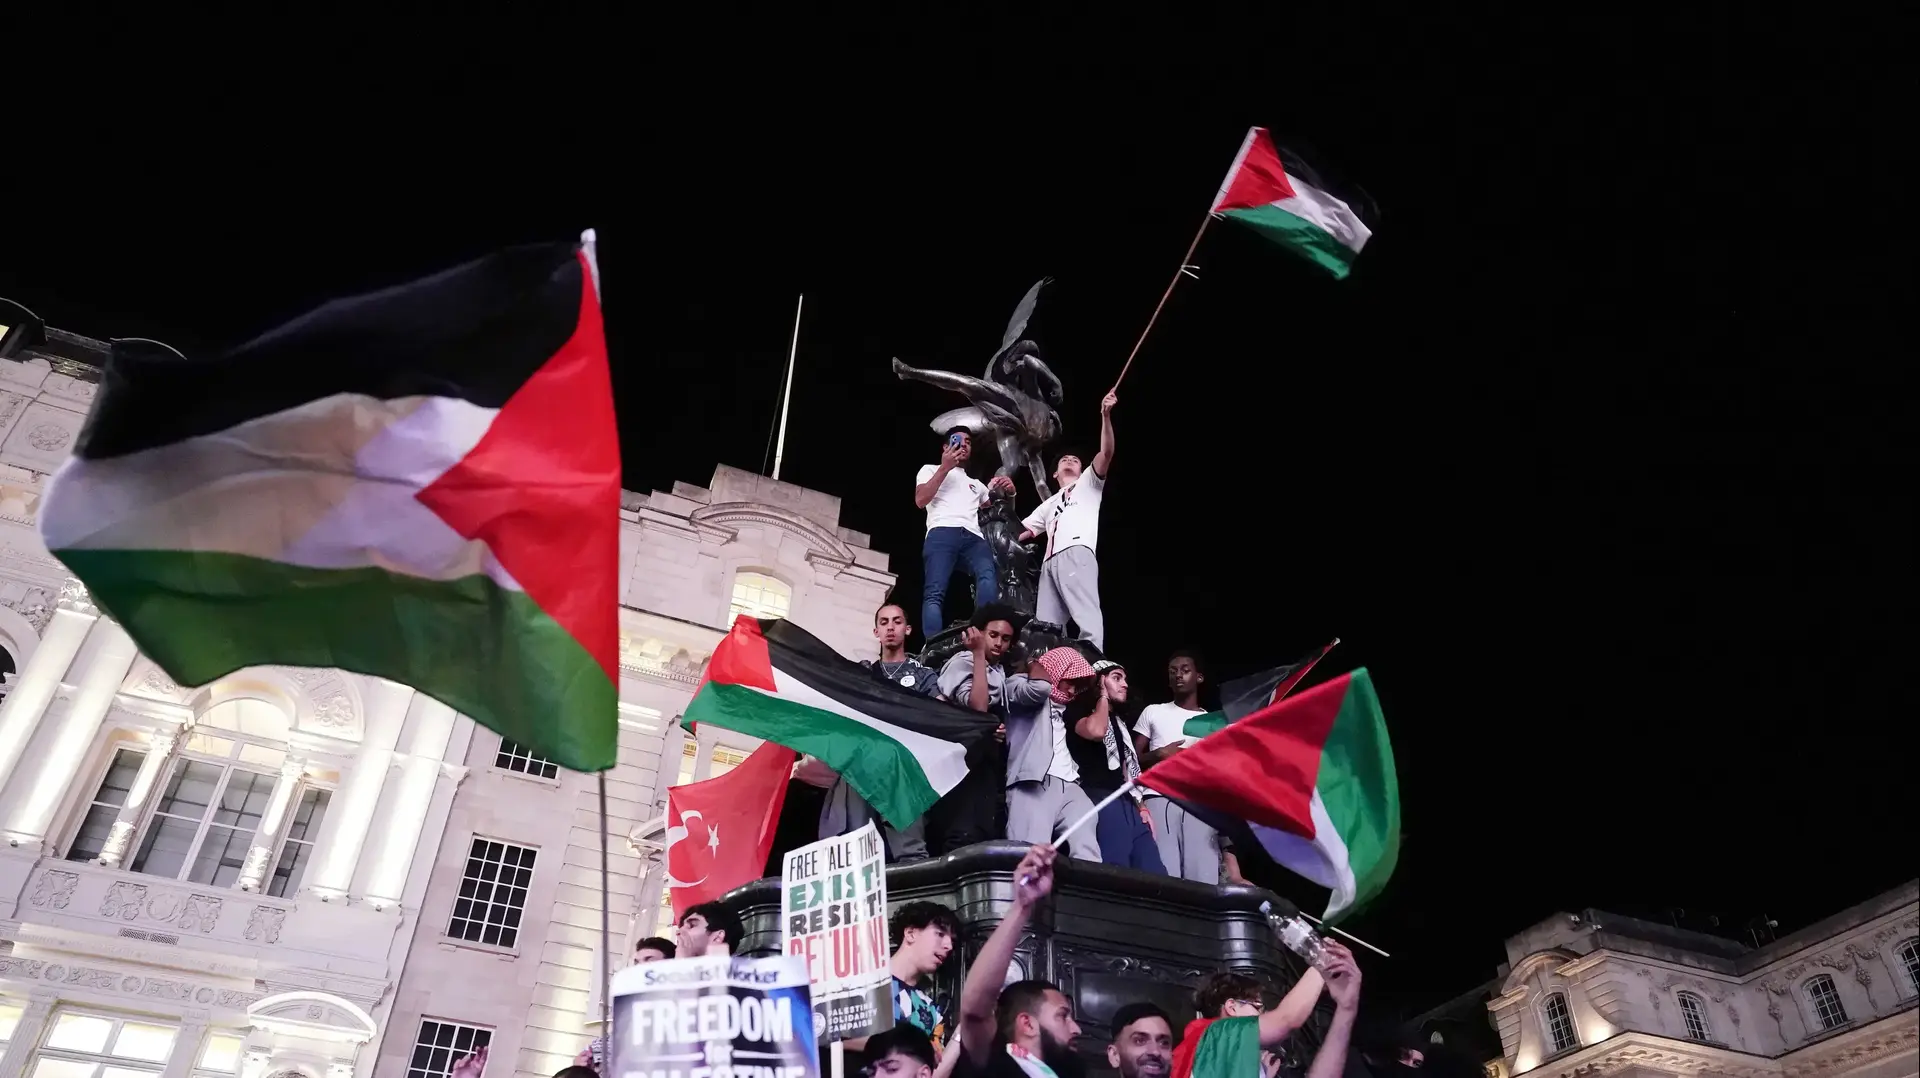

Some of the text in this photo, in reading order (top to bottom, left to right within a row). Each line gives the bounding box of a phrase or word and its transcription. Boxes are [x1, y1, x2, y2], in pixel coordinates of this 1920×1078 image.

[789, 830, 880, 882] FREE ALETINE
[789, 859, 881, 913] EXIST!
[632, 994, 793, 1047] FREEDOM
[828, 1008, 878, 1026] SOLIDARITY
[828, 1018, 873, 1033] CAMPAIGN
